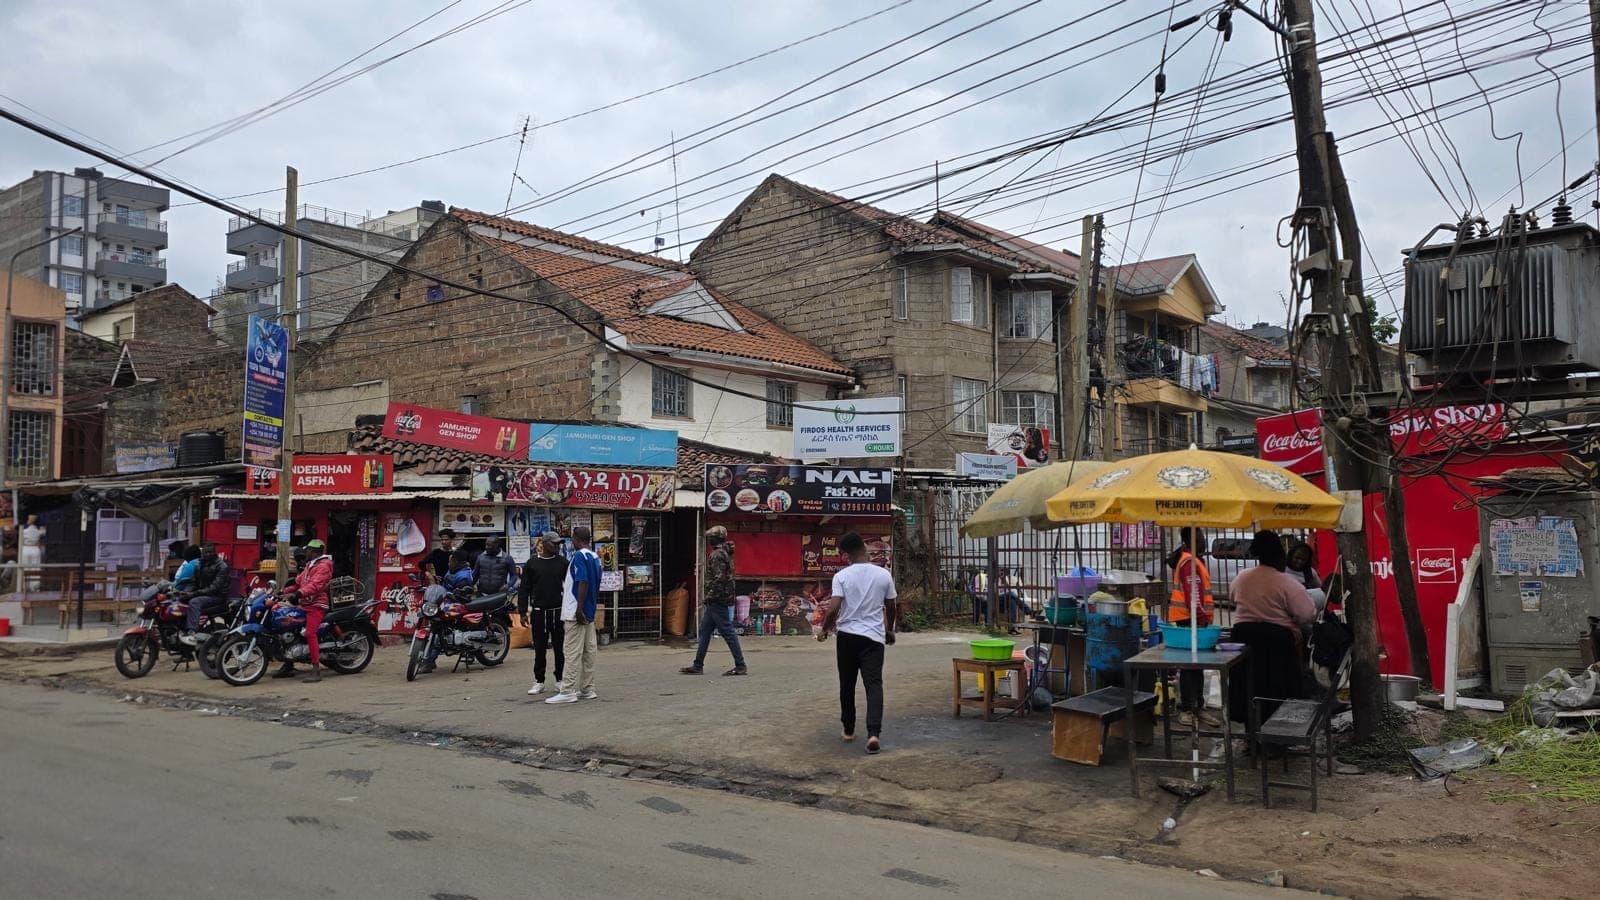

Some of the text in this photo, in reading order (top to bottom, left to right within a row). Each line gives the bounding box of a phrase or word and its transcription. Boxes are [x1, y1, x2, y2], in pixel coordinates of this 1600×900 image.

[1435, 403, 1497, 427] Shop
[438, 421, 481, 434] JAMUHURI
[801, 426, 826, 434] FIRDOS
[856, 424, 891, 432] SERVICES
[439, 429, 477, 441] GEN SHOP
[292, 464, 352, 475] NDEBRHAN
[297, 475, 336, 486] ASFHA
[825, 486, 876, 497] Fast Food
[1155, 499, 1203, 512] PREDATOR
[1420, 557, 1454, 568] Coca-Cola
